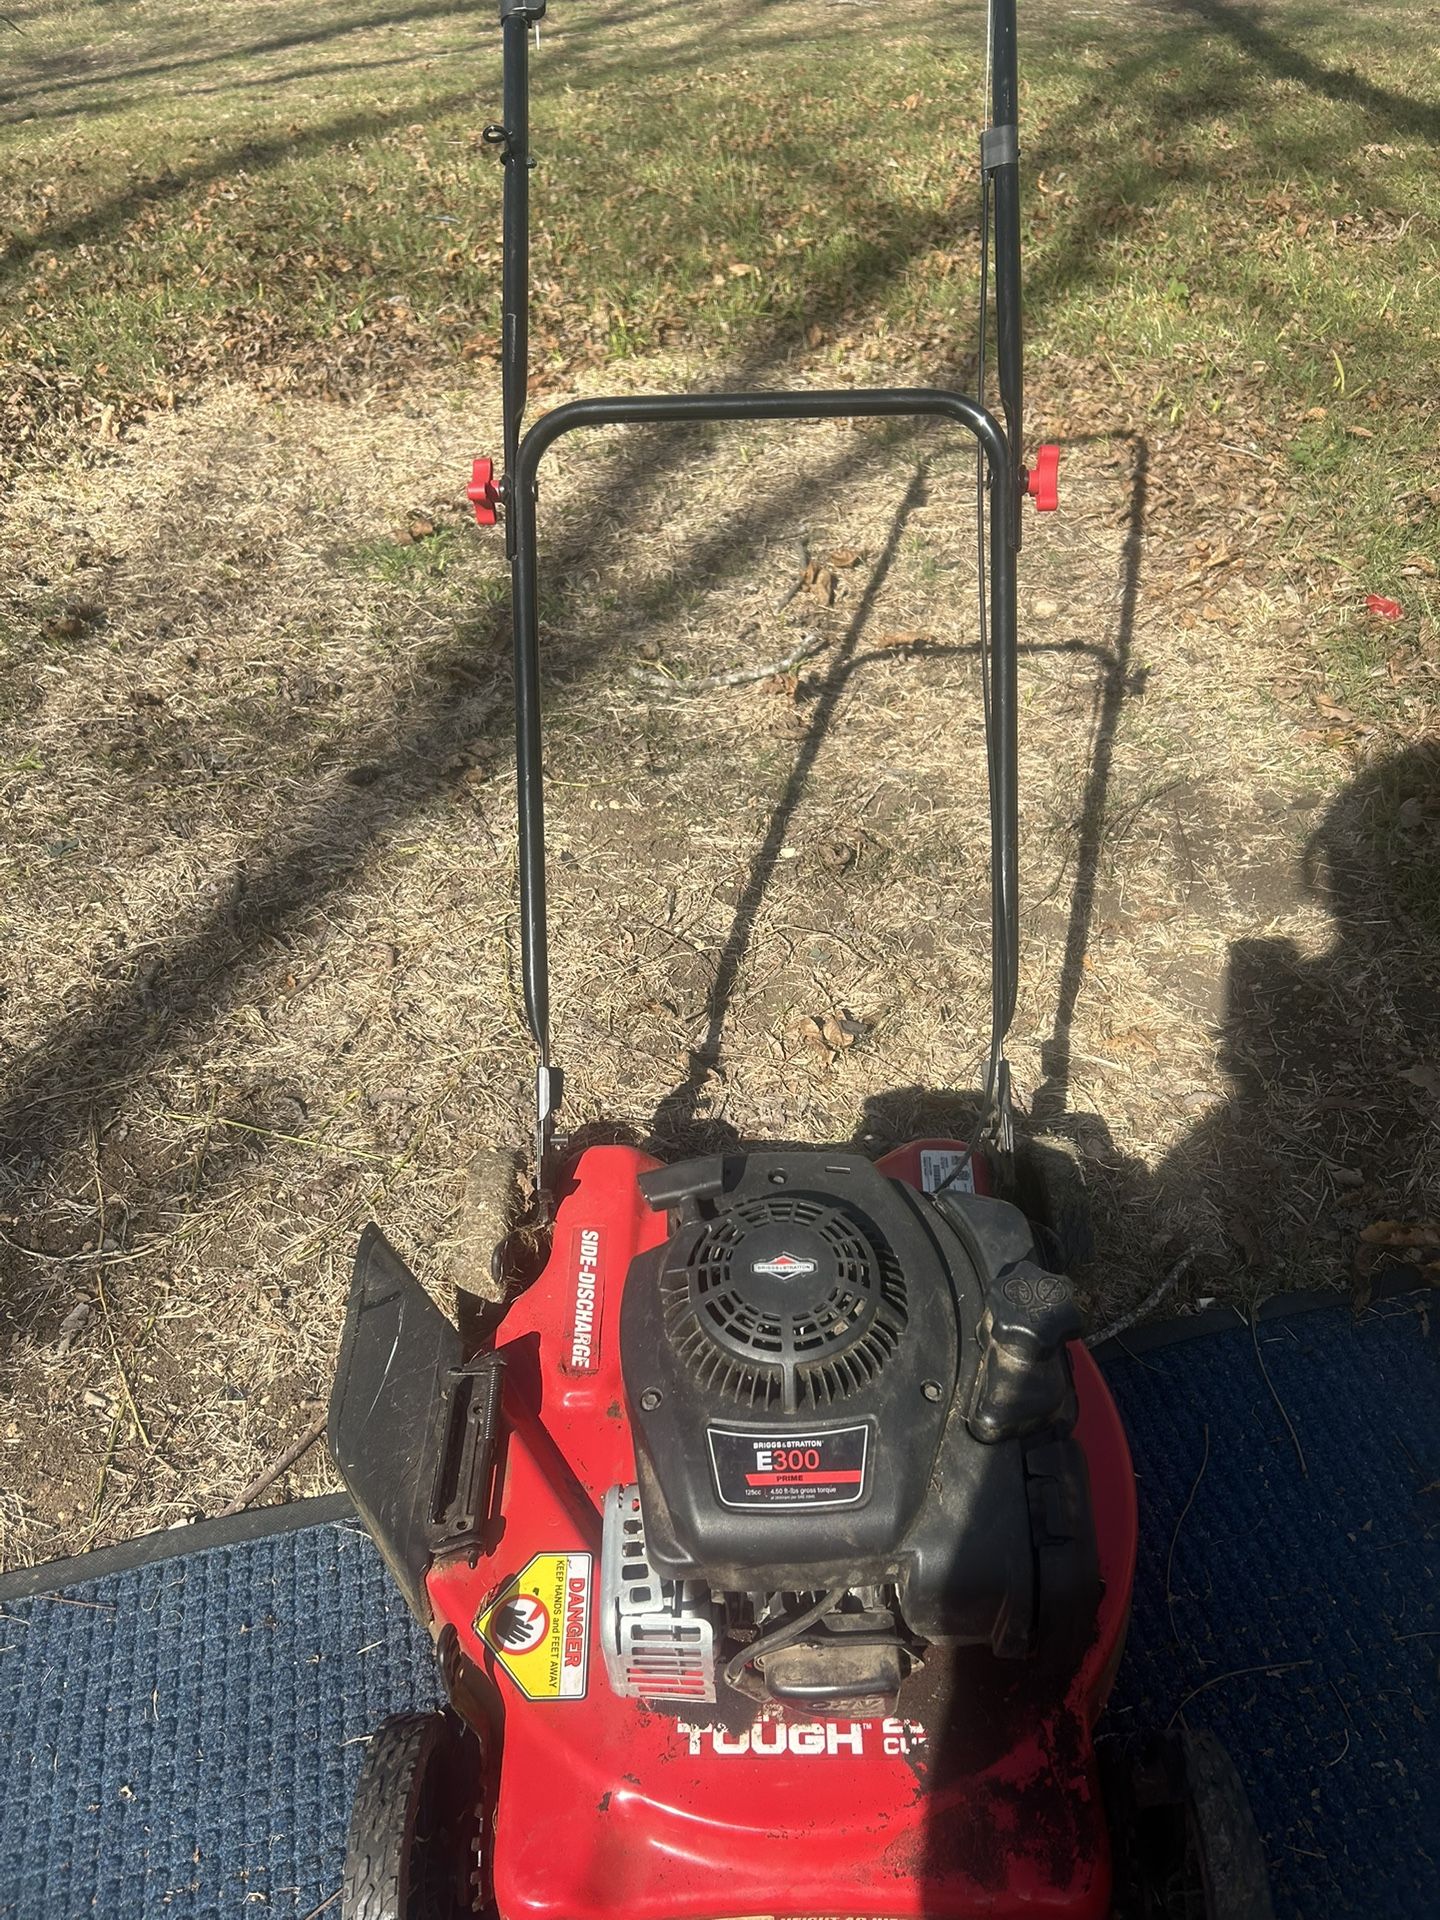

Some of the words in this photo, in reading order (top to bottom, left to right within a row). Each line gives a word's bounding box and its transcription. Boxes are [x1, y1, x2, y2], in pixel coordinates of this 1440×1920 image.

[571, 1230, 599, 1368] SIDE-DISCHARGE
[756, 1449, 820, 1471] E300
[776, 1475, 803, 1483] PRIME
[800, 1487, 817, 1495] gross
[817, 1487, 837, 1495] torque
[556, 1560, 565, 1582] KEEP
[553, 1585, 563, 1615] HANDS
[552, 1617, 561, 1634] and
[564, 1577, 586, 1668] DANGER
[551, 1636, 560, 1659] FEET
[548, 1661, 558, 1689] AWAY
